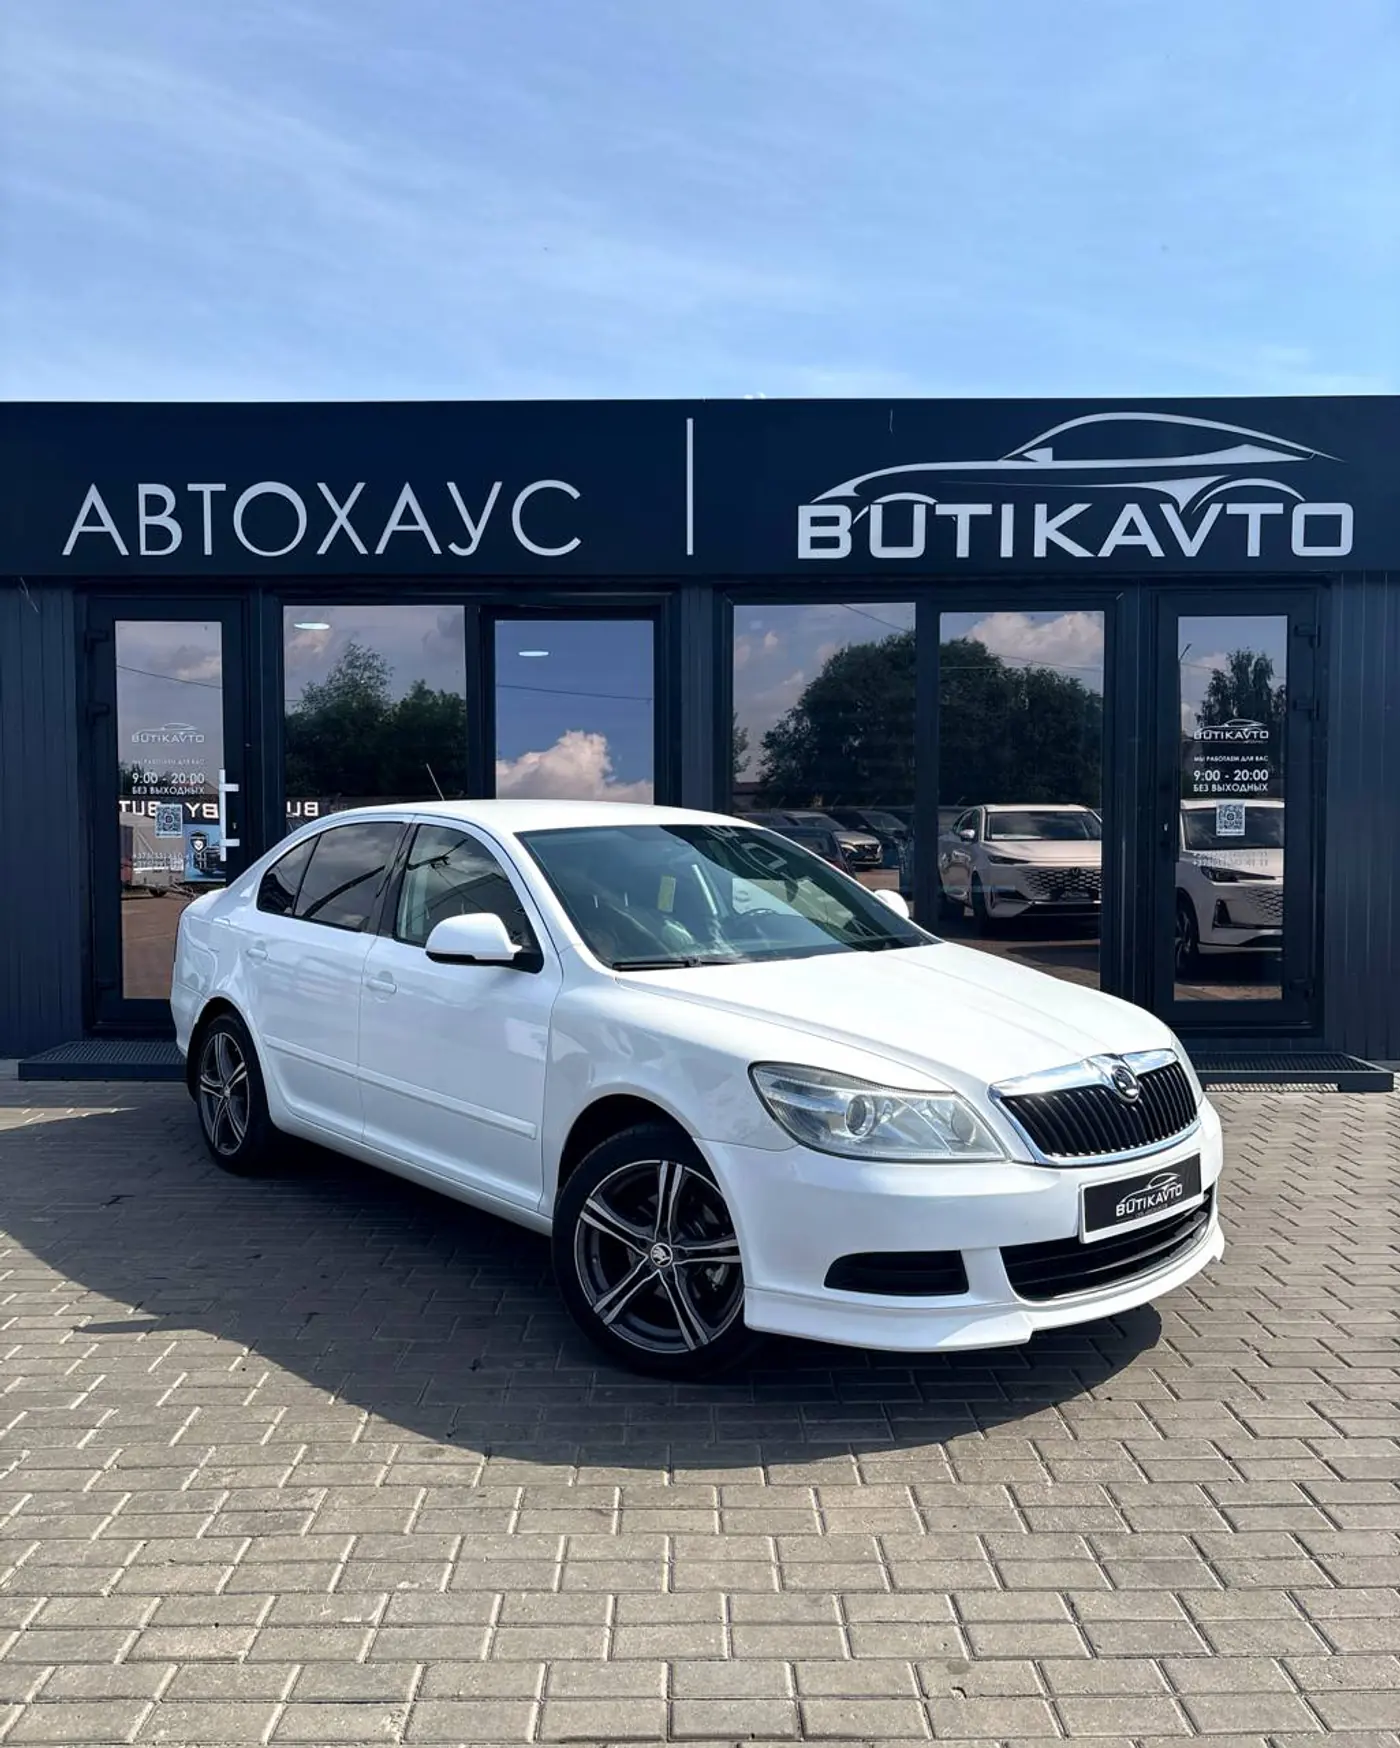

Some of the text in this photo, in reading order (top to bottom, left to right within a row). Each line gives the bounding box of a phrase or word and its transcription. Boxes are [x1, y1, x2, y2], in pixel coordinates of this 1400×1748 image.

[62, 479, 582, 557] АВТОХАУС
[797, 502, 1354, 559] BUTIKAVTO
[1193, 730, 1269, 740] BUTIKAVTO
[132, 772, 159, 784] 9:00
[170, 772, 205, 784] 20:00
[1193, 769, 1221, 781] 9:00
[1233, 769, 1269, 781] 20:00
[132, 786, 205, 796] БЕЗ ВЫХОДНЫХ
[1193, 783, 1269, 793] БЕЗ ВЫХОДНЫХ
[1115, 1183, 1183, 1217] BUTIKAVTO
